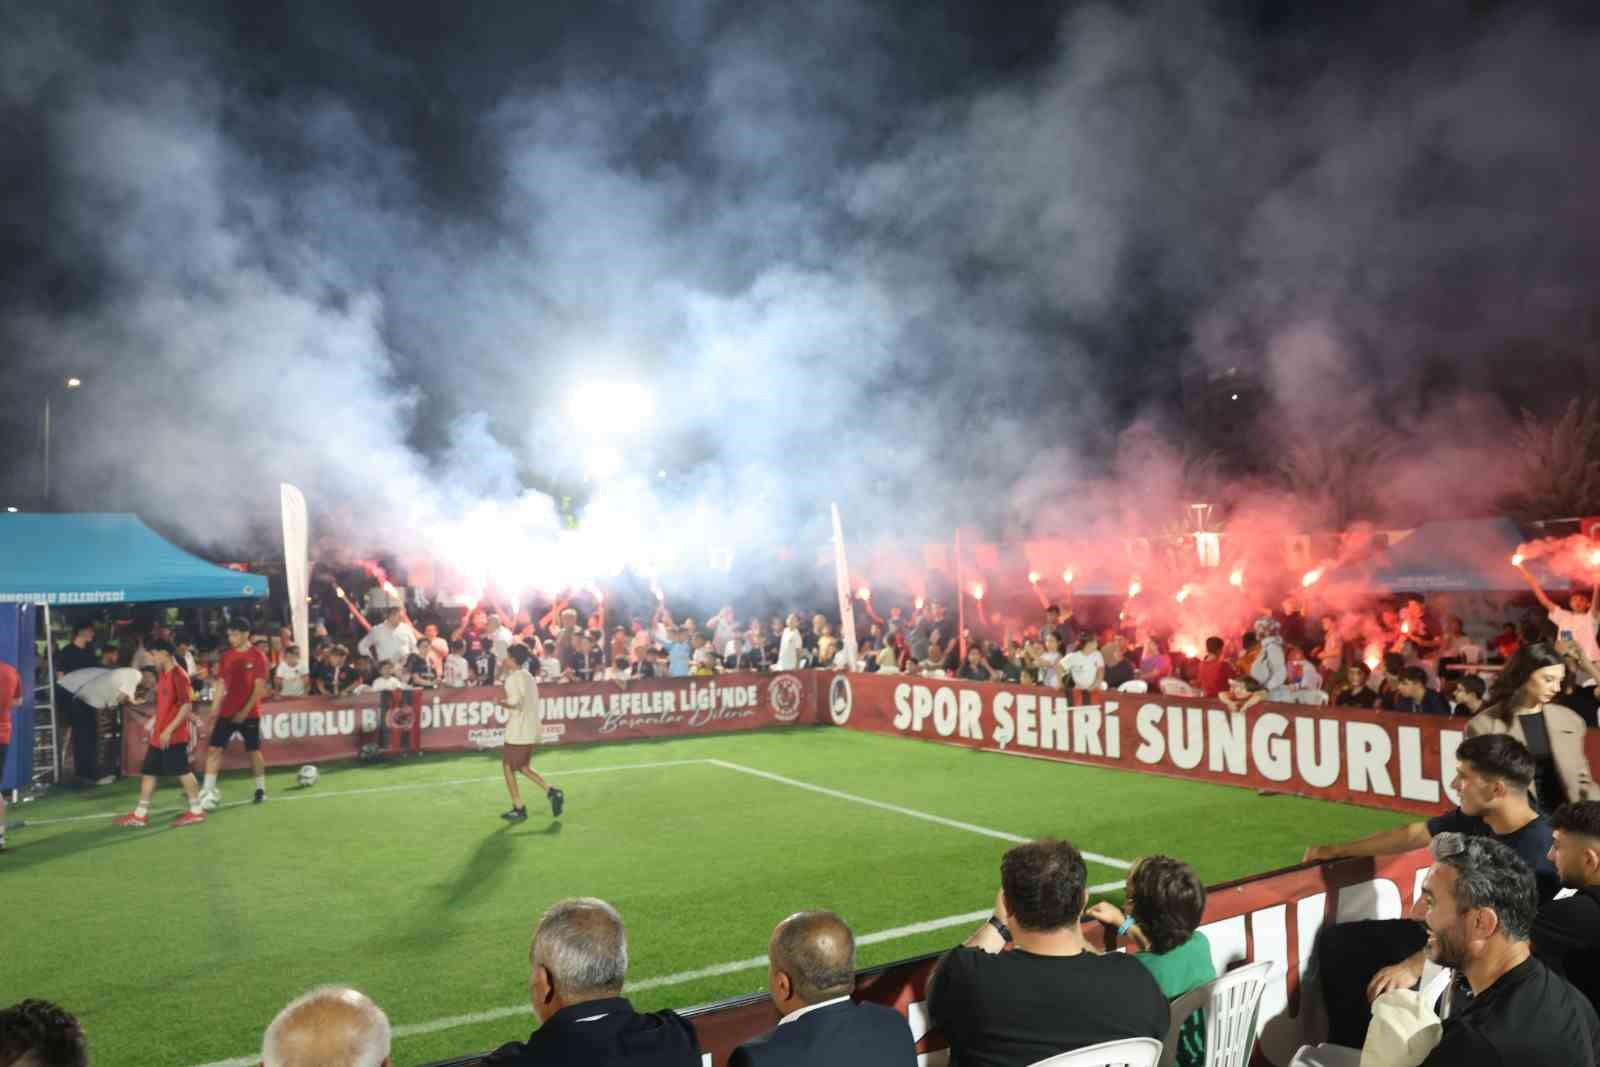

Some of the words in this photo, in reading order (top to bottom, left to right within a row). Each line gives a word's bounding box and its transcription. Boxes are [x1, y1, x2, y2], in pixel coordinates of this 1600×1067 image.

[259, 709, 354, 739] NGURLU
[609, 690, 676, 715] EFELER
[680, 680, 758, 712] LİGİ'NDE
[893, 682, 984, 741] SPOR
[992, 690, 1121, 759] ŞEHRİ
